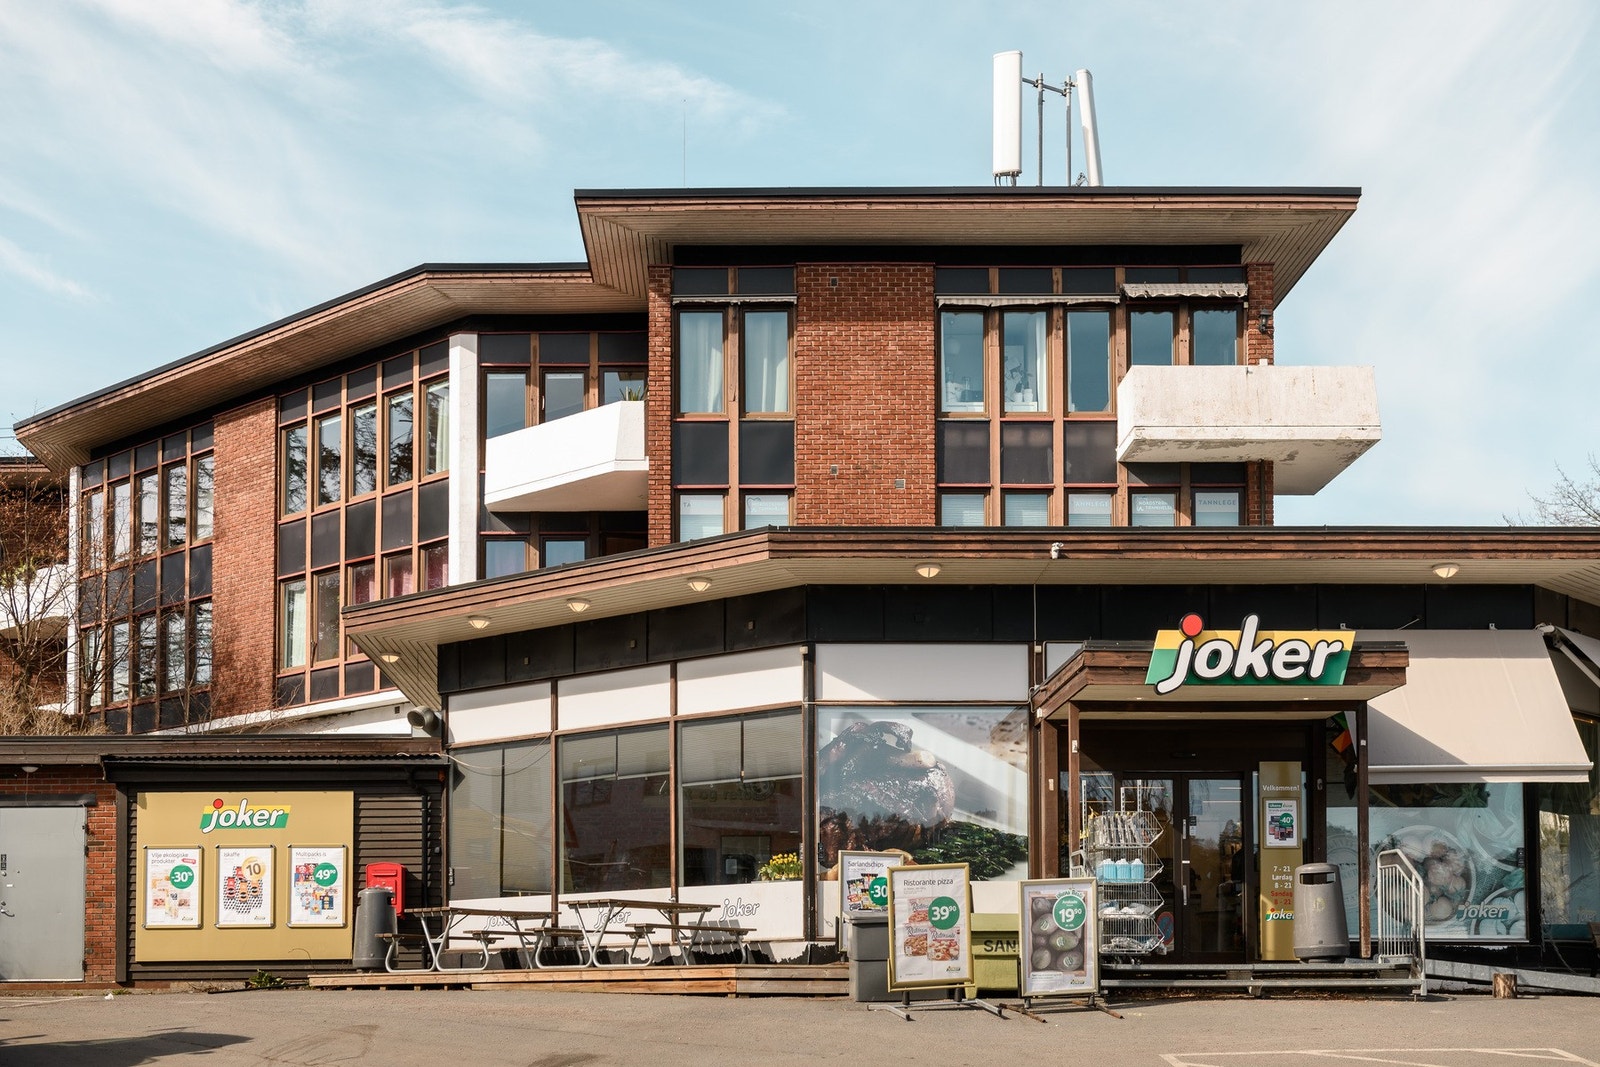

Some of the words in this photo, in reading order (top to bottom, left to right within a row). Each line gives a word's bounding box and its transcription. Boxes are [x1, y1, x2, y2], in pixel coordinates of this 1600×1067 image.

[1154, 612, 1344, 695] joker
[202, 798, 285, 834] joker
[246, 863, 261, 876] 10
[903, 879, 936, 887] Ristorante
[937, 878, 954, 886] pizza
[719, 897, 760, 922] joker
[1460, 902, 1507, 921] joker
[984, 940, 1019, 952] SAN
